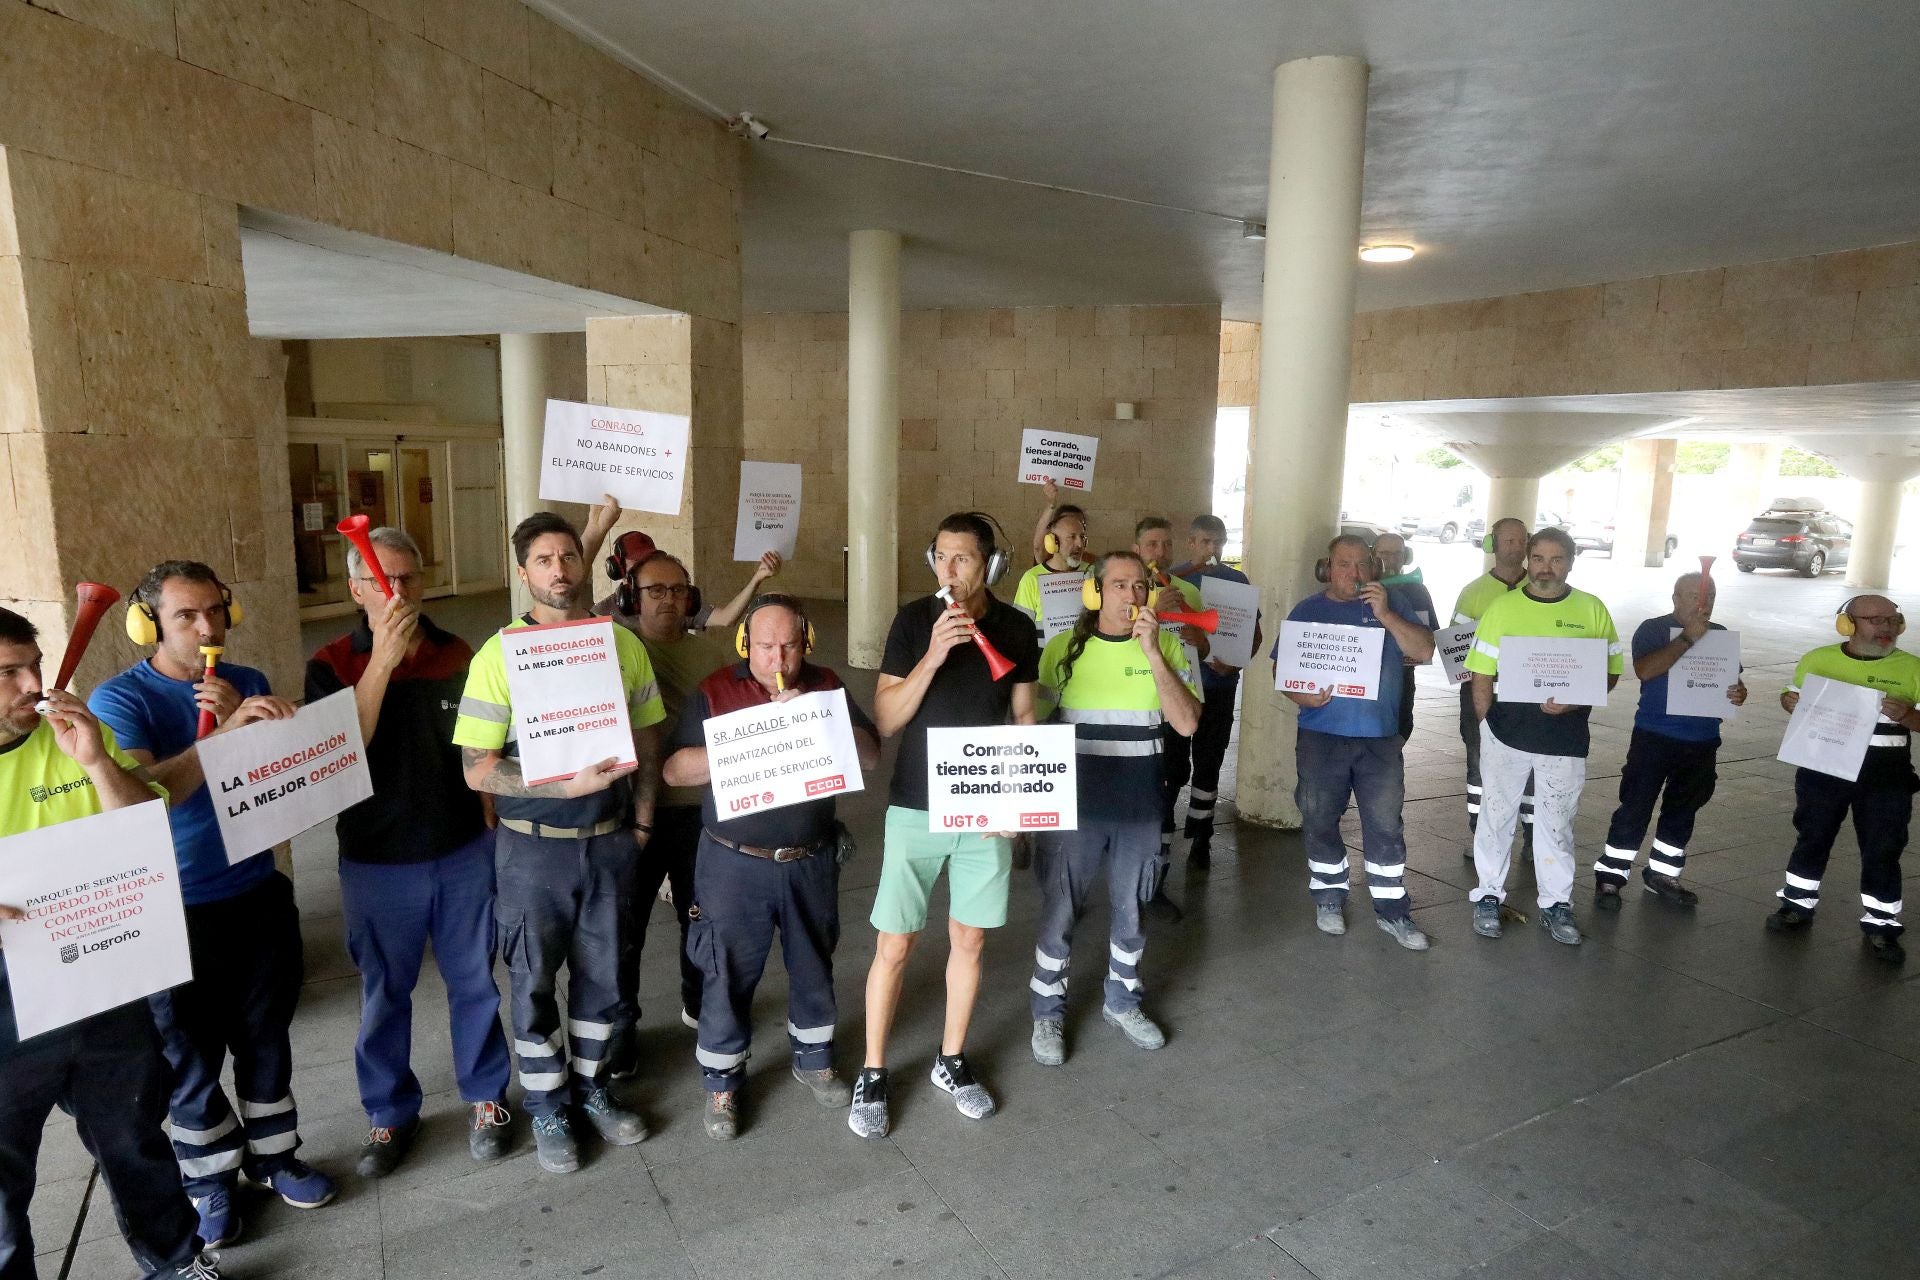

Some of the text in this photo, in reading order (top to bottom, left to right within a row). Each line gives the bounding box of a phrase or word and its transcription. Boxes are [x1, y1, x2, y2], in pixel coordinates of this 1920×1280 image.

[591, 419, 644, 435] CONRADO,
[577, 439, 592, 448] NO
[595, 441, 657, 457] ABANDONES
[1040, 438, 1079, 451] Conrado,
[1026, 447, 1052, 456] tienes
[1063, 451, 1091, 462] parque
[552, 457, 674, 480] EL PARQUE DE SERVICIOS
[1031, 457, 1084, 470] abandonado
[1312, 632, 1346, 641] PARQUE
[530, 637, 605, 655] NEGOCIACIÓN
[1297, 641, 1340, 651] SERVICIOS
[1443, 643, 1470, 655] tienes
[532, 659, 564, 669] MEJOR
[566, 652, 607, 665] OPCIÓN
[1301, 652, 1337, 661] ABIERTO
[1299, 662, 1357, 673] NEGOCIACIÓN
[1456, 671, 1471, 680] UGT
[1285, 680, 1306, 689] UGT
[527, 702, 616, 724] LA NEGOCIACIÓN
[543, 725, 575, 737] MEJOR
[577, 717, 618, 731] OPCIÓN
[713, 708, 833, 744] SR. ALCALDE, NO A LA
[717, 737, 815, 767] PRIVATIZACIÓN DEL
[963, 743, 1039, 758] Conrado,
[221, 732, 347, 793] LA NEGOCIACIÓN
[936, 761, 1067, 777] tienes al parque
[720, 755, 833, 789] PARQUE DE SERVICIOS
[228, 752, 359, 818] LA MEJOR OPCIÓN
[808, 777, 843, 793] CCOO
[950, 779, 1054, 794] abandonado
[730, 794, 759, 812] UGT
[943, 815, 973, 827] UGT
[1022, 815, 1057, 825] CCOO
[26, 866, 148, 907] PARQUE DE SERVICIOS
[94, 886, 114, 900] DE
[117, 872, 165, 894] HORAS
[44, 892, 144, 929] COMPROMISO
[50, 905, 143, 942] INCUMPLIDO
[83, 929, 141, 954] Logroño
